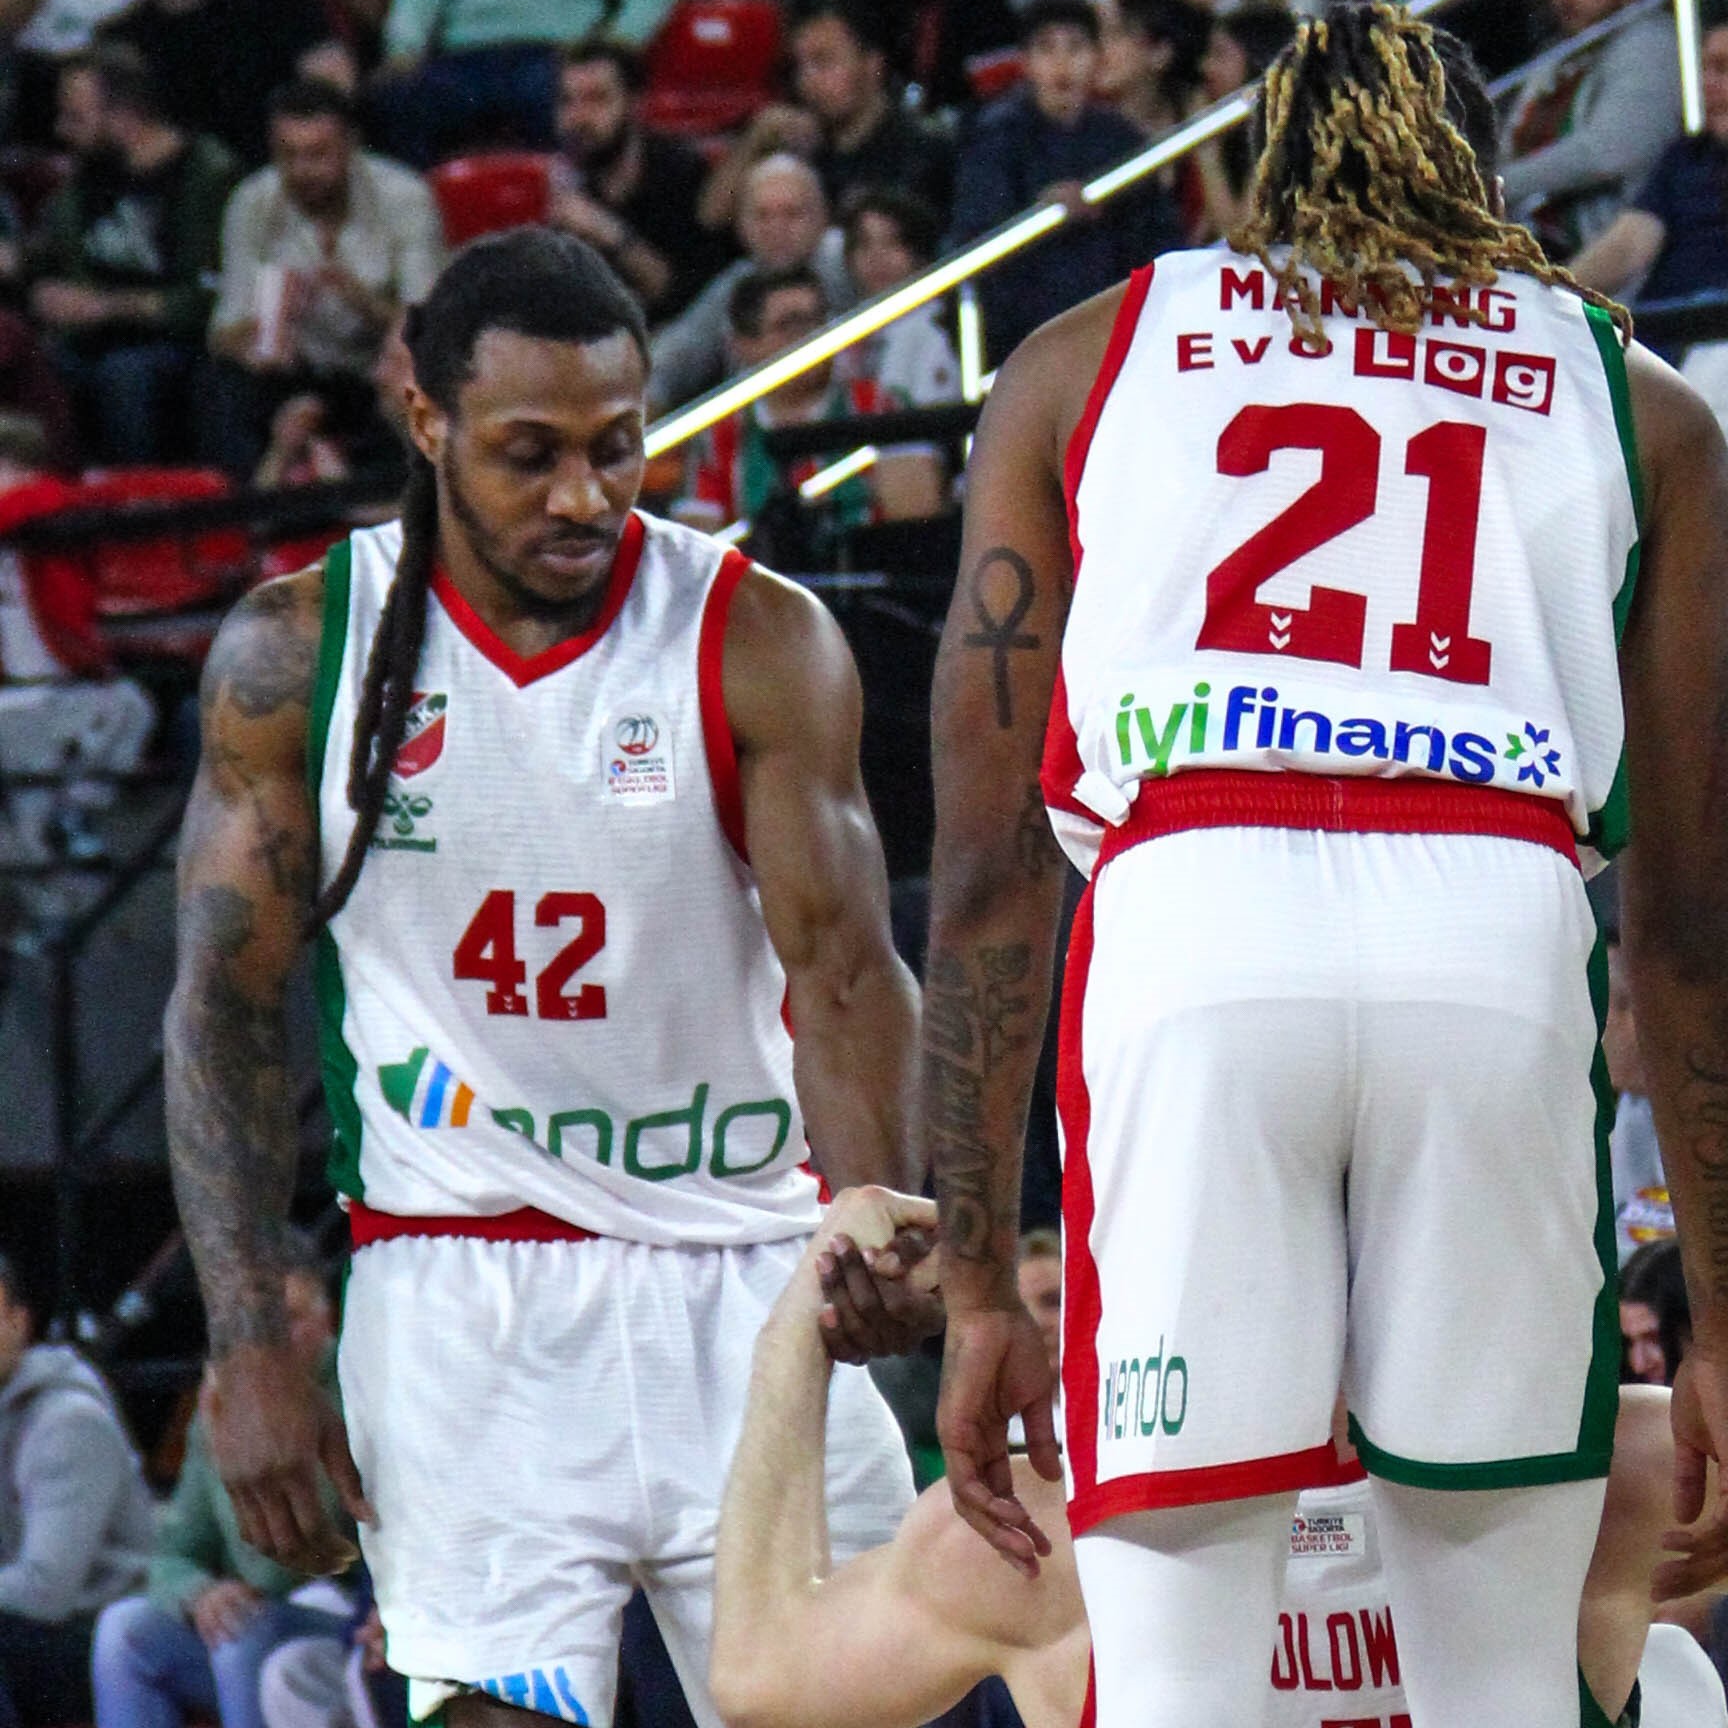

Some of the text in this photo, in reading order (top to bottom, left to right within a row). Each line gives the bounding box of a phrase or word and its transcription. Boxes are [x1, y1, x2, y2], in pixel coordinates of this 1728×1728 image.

[1195, 402, 1492, 686] 21
[1115, 680, 1499, 785] iyi finans
[453, 889, 608, 1020] 42
[1114, 1333, 1188, 1440] endo
